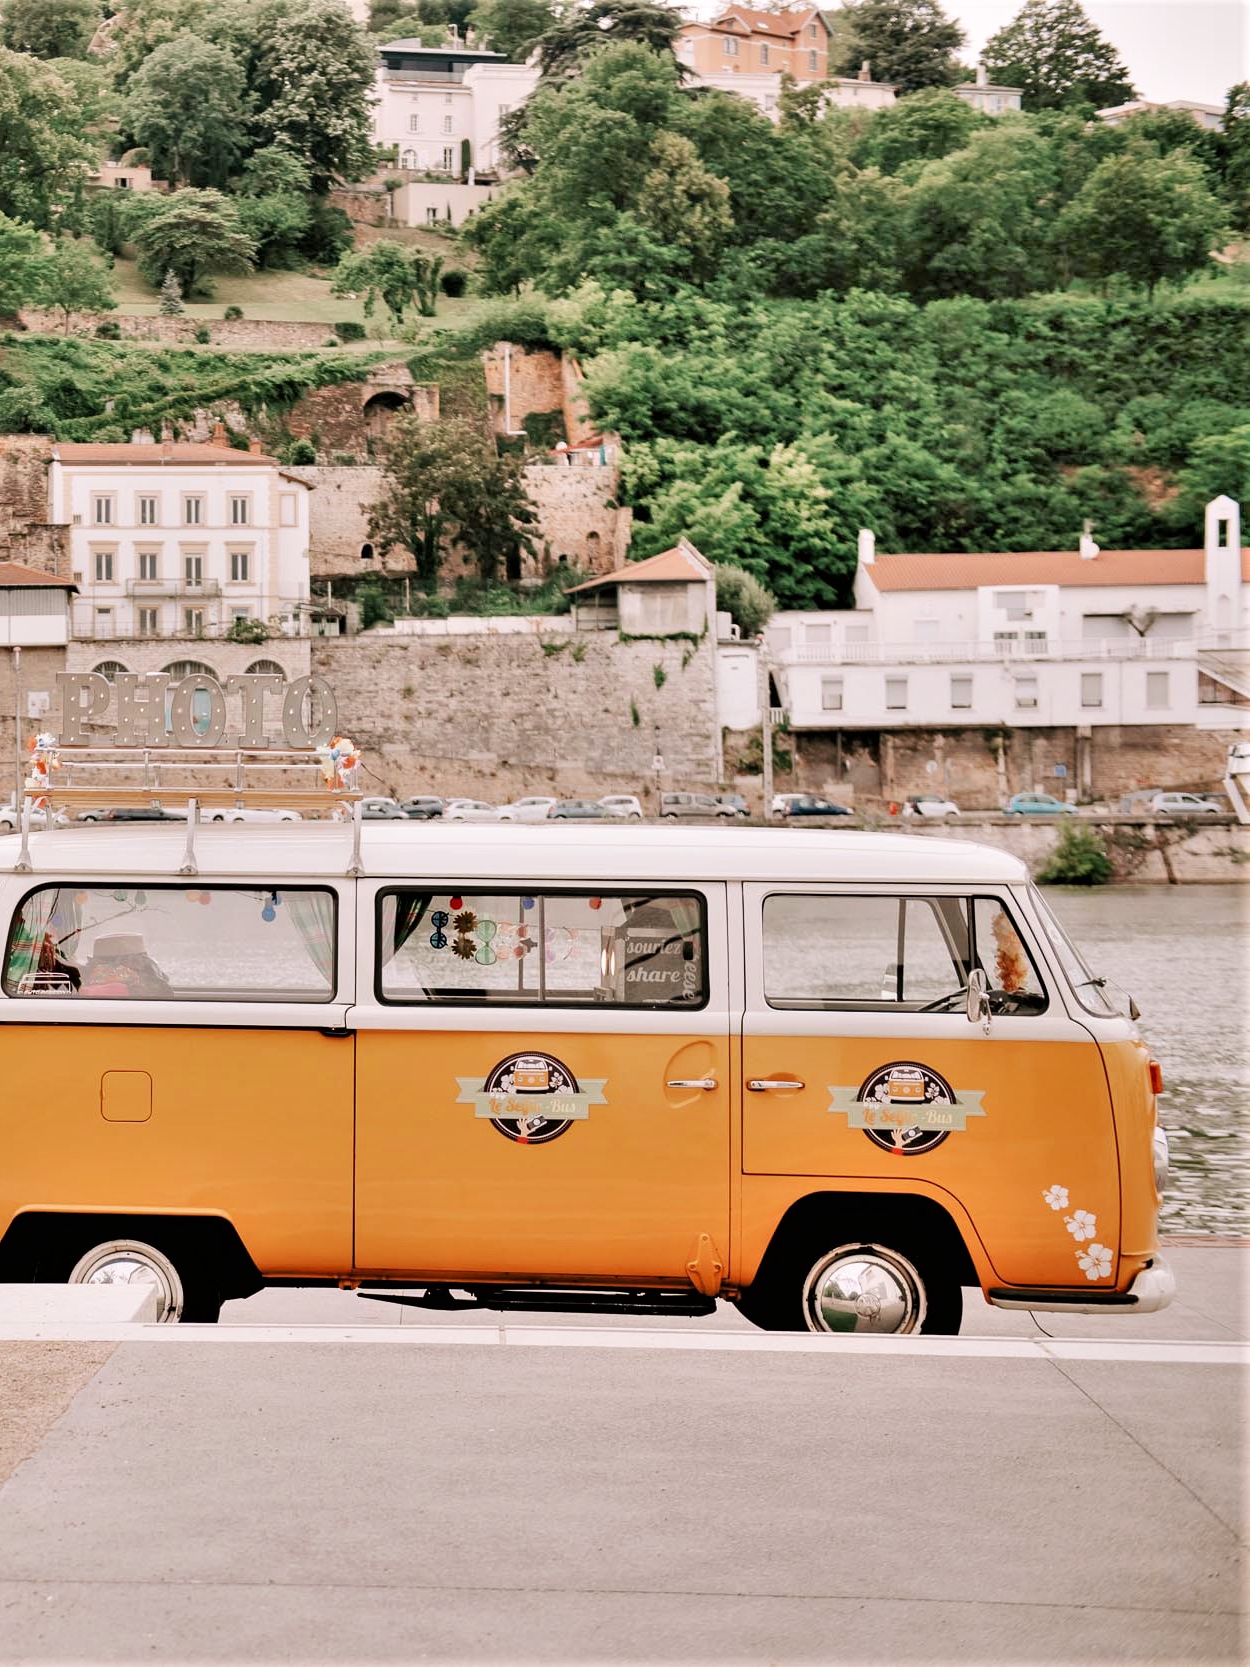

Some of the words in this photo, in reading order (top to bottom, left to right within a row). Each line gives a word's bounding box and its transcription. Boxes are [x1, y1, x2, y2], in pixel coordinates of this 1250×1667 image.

[56, 671, 339, 748] PHOTO
[626, 940, 682, 954] souriez
[626, 966, 681, 983] share
